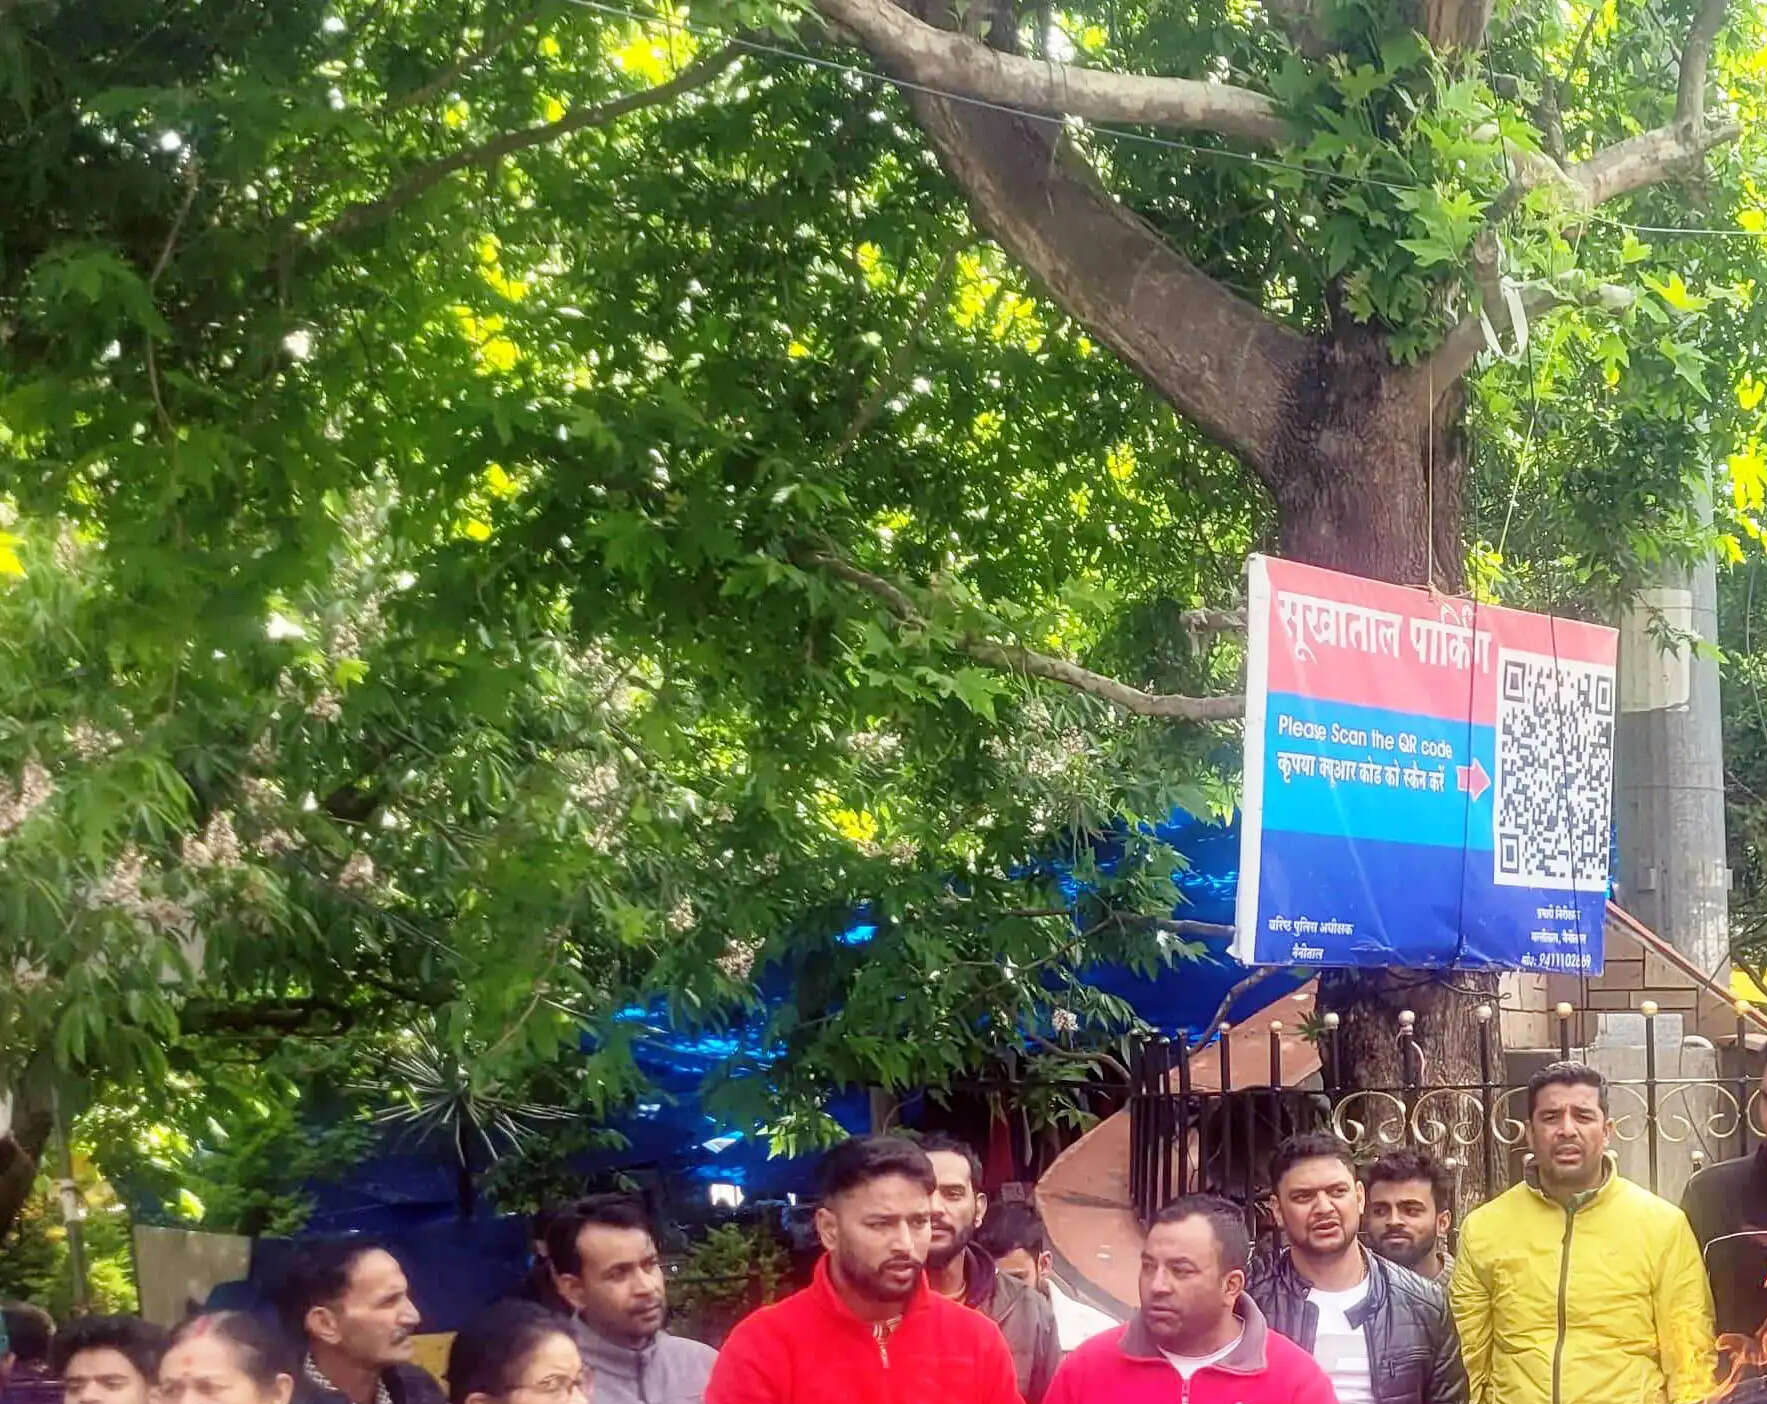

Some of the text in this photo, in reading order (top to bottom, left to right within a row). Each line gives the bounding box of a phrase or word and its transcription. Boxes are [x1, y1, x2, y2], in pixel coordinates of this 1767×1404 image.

[1277, 590, 1404, 664] सूखाताल
[1277, 714, 1453, 760] Please Scan the QR code
[1276, 751, 1317, 783] कृपया
